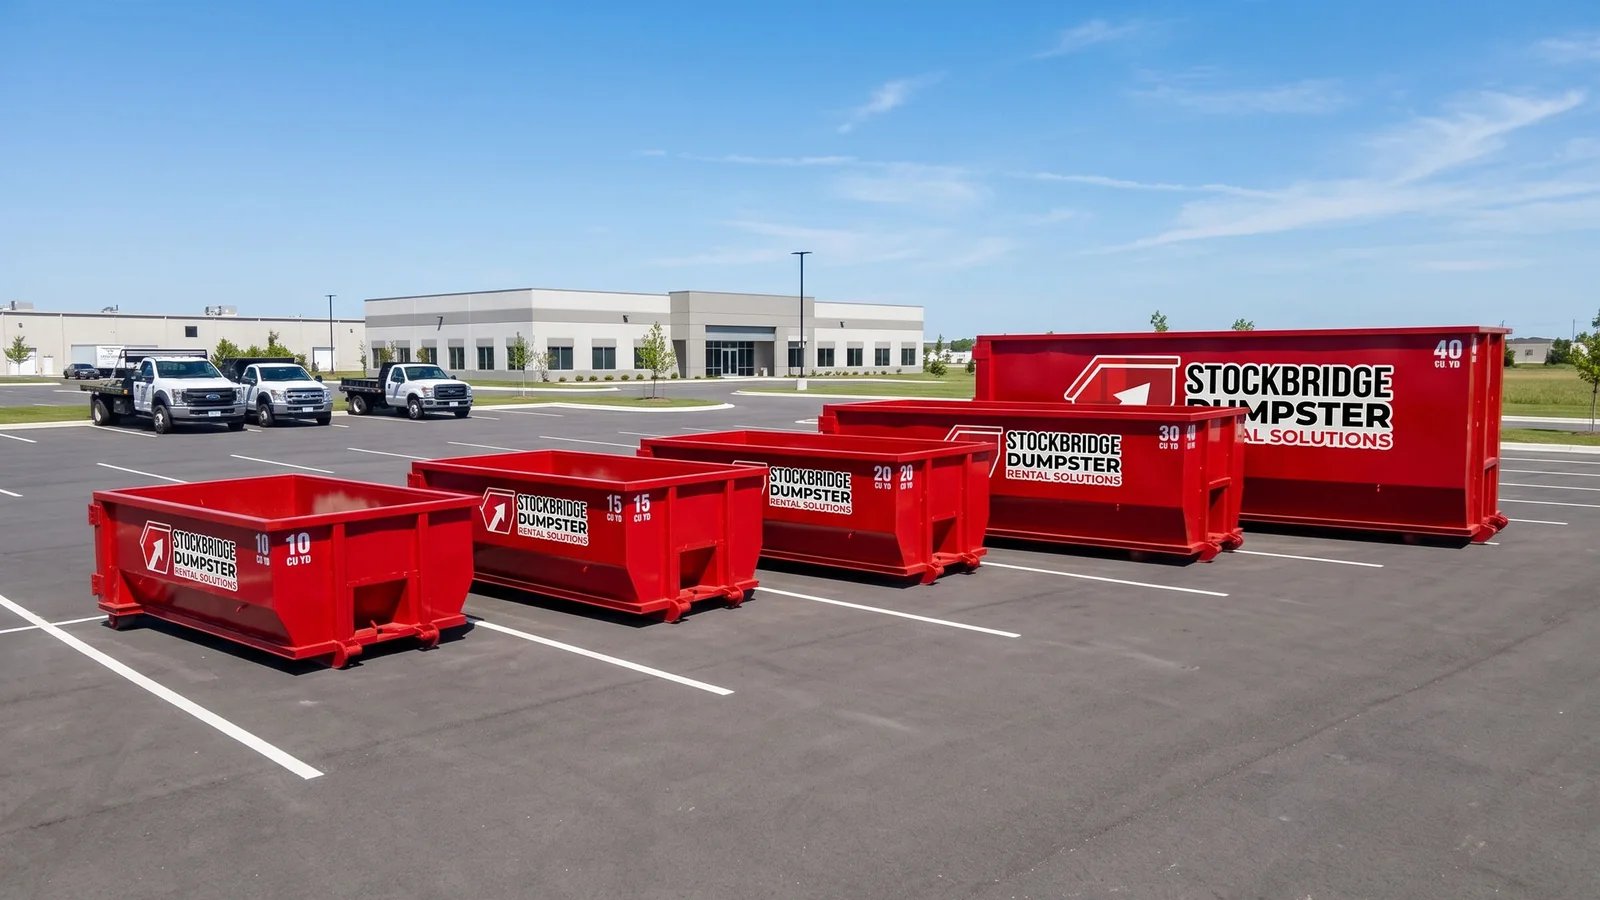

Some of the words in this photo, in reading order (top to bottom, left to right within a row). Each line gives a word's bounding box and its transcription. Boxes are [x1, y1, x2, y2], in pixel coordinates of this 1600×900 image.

[1434, 340, 1462, 359] 40
[1187, 365, 1392, 398] STOCKBRIDGE
[1187, 399, 1390, 428] MPSTER
[1159, 425, 1179, 441] 30
[1270, 430, 1391, 448] SOLUTIONS
[1006, 432, 1120, 455] STOCKBRIDGE
[900, 464, 913, 481] 20
[1008, 453, 1120, 473] DUMPSTER
[770, 468, 850, 488] STOCKBRIDGE
[874, 466, 891, 482] 20
[1008, 469, 1050, 480] RENTAL
[1054, 472, 1120, 485] SOLUTIONS
[607, 494, 622, 513] 15
[634, 494, 650, 512] 15
[770, 485, 850, 503] DUMPSTER
[518, 495, 587, 519] STOCKBRIDGE
[770, 498, 801, 508] RENTAL
[803, 501, 851, 513] SOLUTIONS
[518, 513, 587, 534] DUMPSTER
[607, 513, 614, 522] CU
[634, 514, 642, 522] CU
[643, 513, 651, 521] YD
[173, 530, 236, 561] STOCKBRIDGE
[256, 533, 269, 555] 10
[286, 532, 310, 555] 10
[519, 527, 545, 538] RENTAL
[547, 531, 588, 545] SOLUTIONS
[174, 552, 236, 578] DUMPSTER
[287, 557, 298, 566] CU
[300, 555, 311, 564] YD
[175, 566, 198, 582] RENTAL
[200, 573, 237, 590] SOLUTIONS
